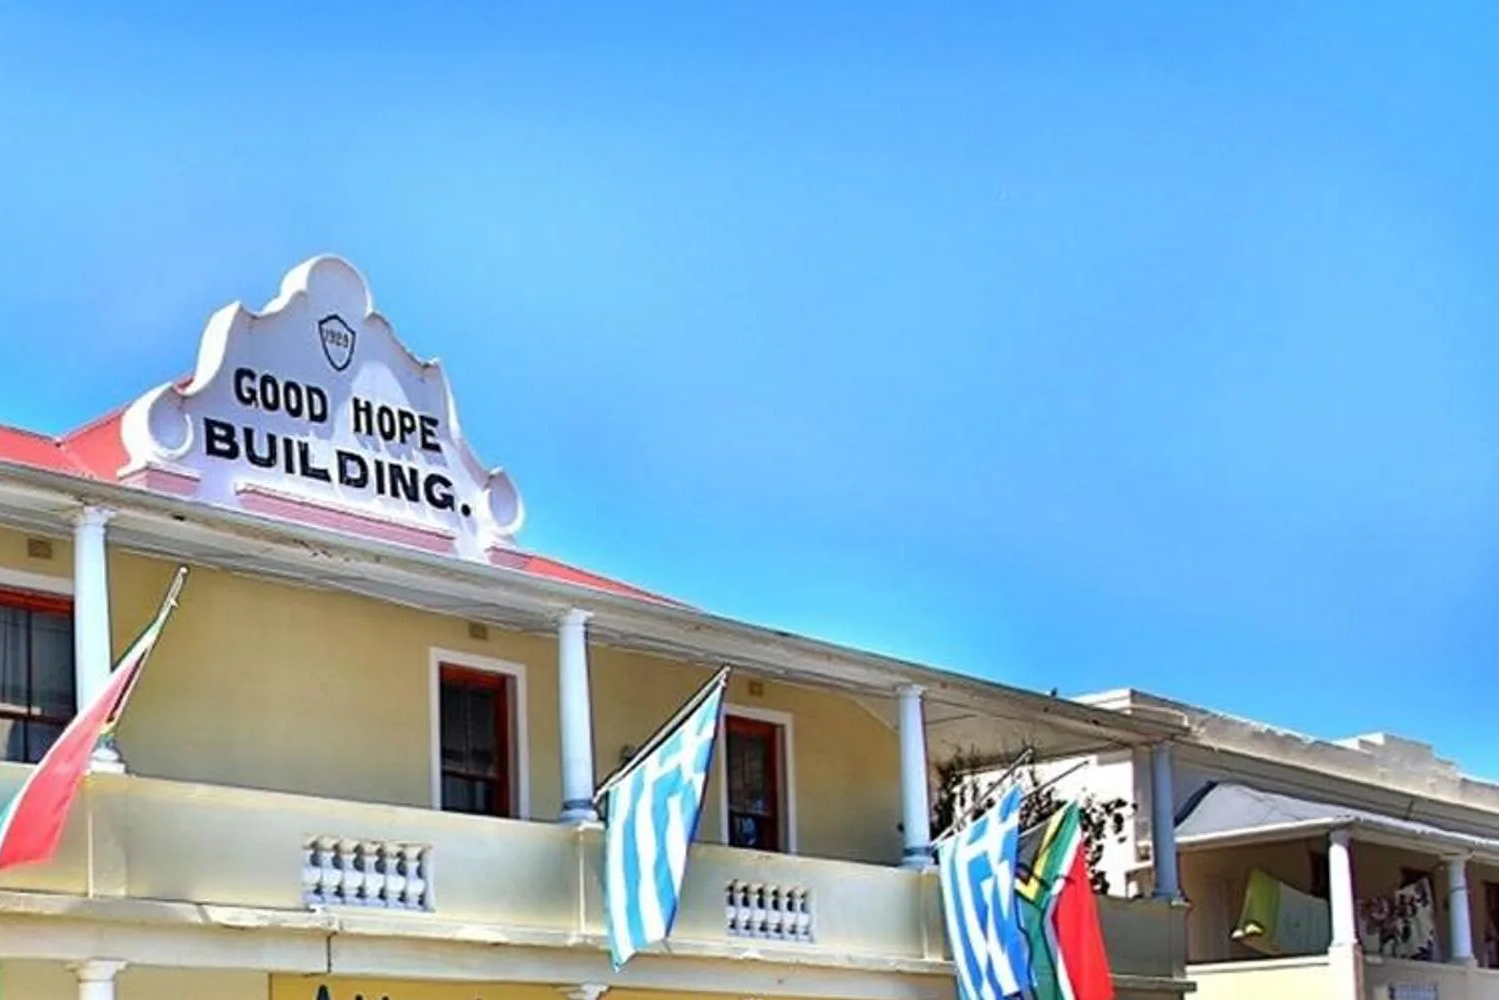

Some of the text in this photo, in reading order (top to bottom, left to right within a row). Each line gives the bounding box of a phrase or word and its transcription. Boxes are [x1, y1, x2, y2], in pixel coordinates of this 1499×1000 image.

[233, 366, 442, 453] GOOD HOPE
[203, 416, 471, 517] BUILDING.
